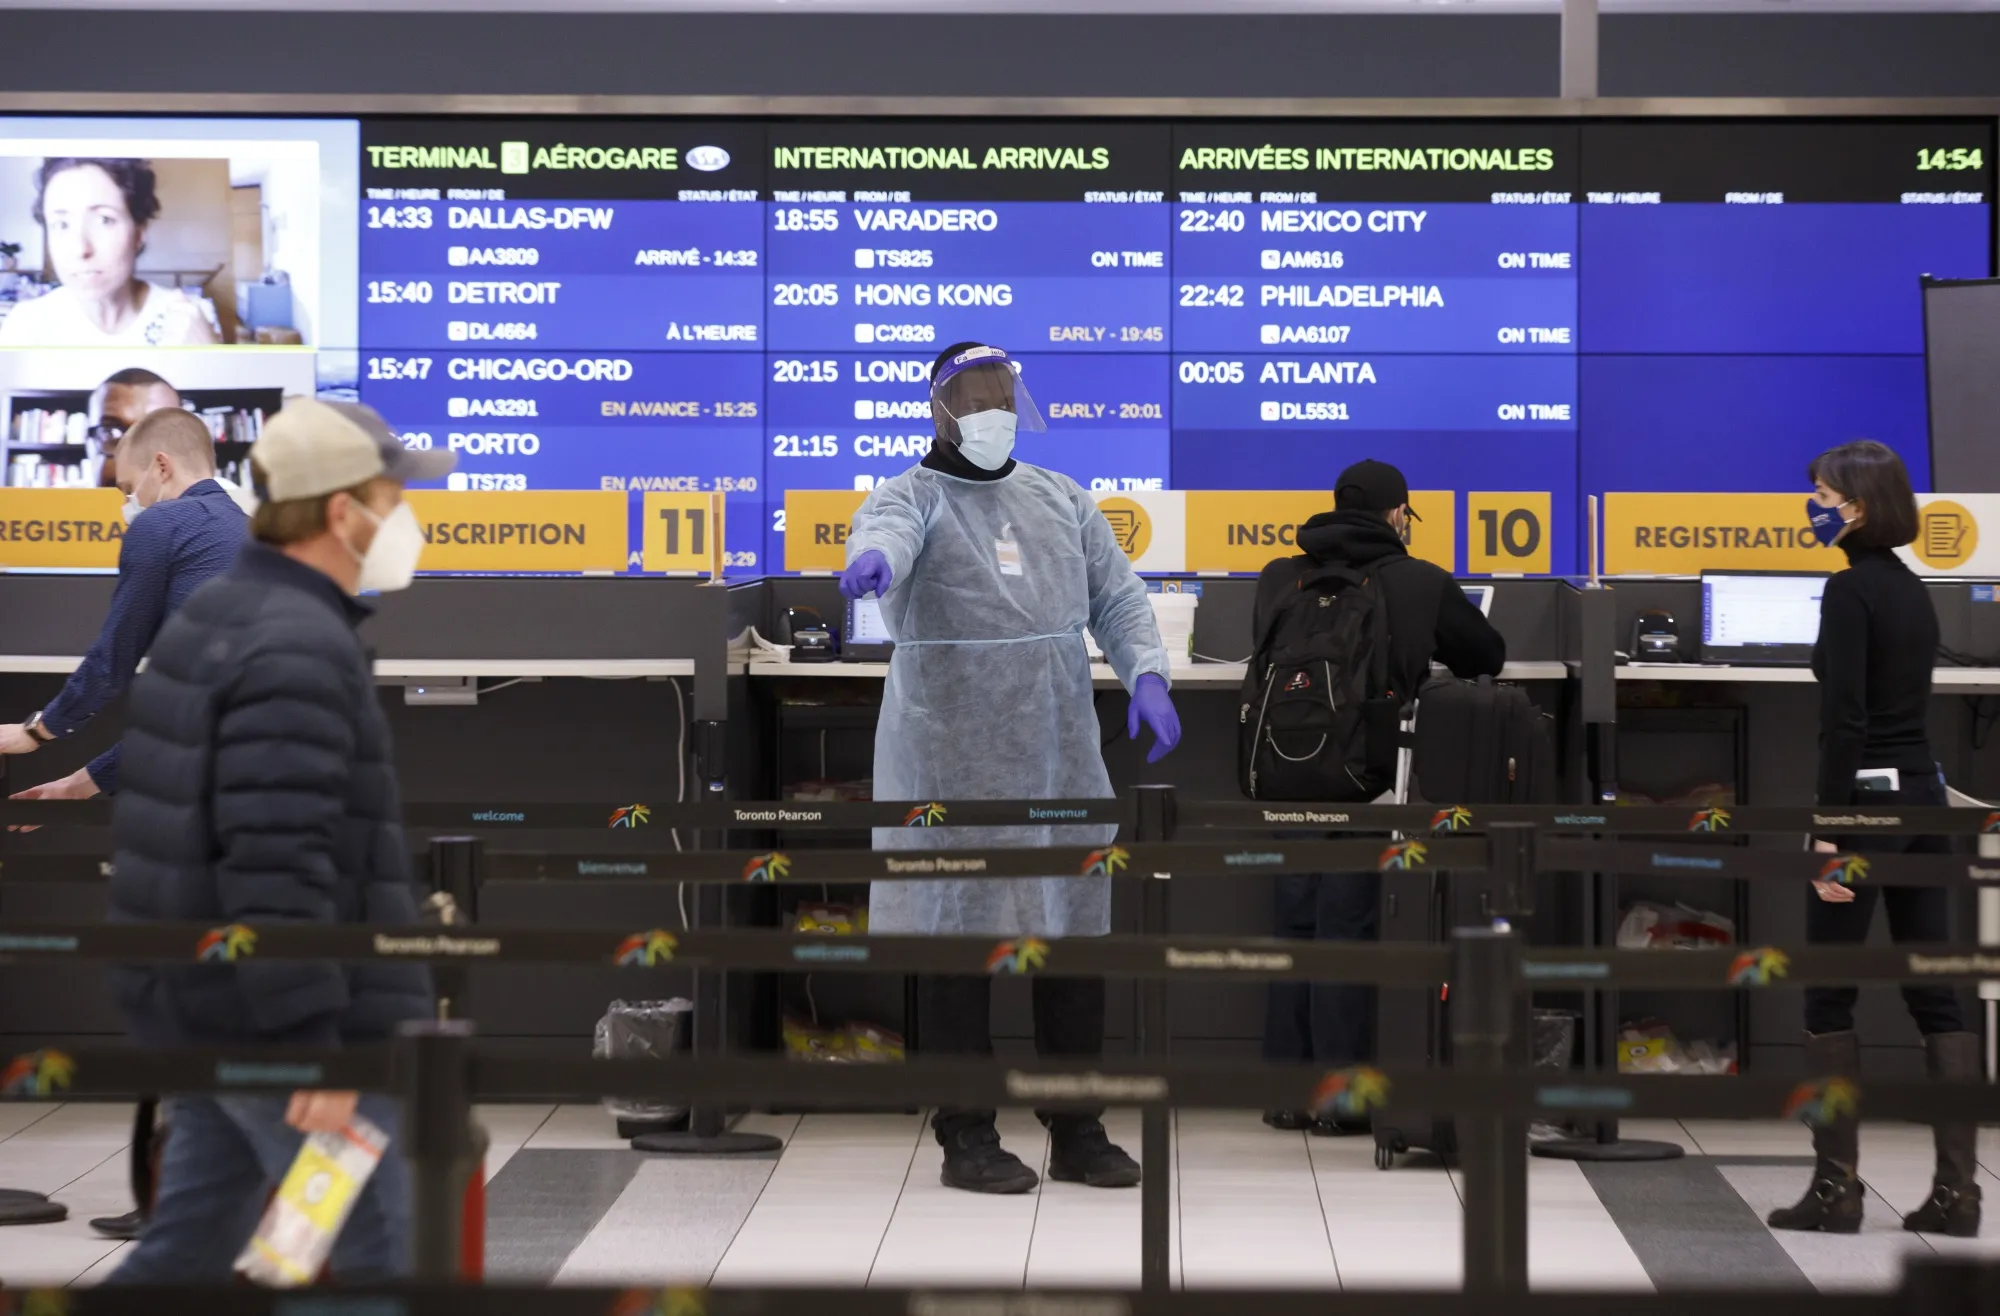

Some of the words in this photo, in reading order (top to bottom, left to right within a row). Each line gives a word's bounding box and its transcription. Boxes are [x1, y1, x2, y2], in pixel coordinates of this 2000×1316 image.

[367, 146, 497, 168] TERMINAL
[532, 143, 677, 169] AÉROGARE
[775, 147, 977, 169] INTERNATIONAL
[983, 148, 1109, 169] ARRIVALS
[1180, 144, 1309, 170] ARRIVÉES
[1316, 148, 1553, 170] INTERNATIONALES
[1917, 149, 1983, 170] 14:54
[368, 207, 432, 228] 14:33
[449, 207, 613, 229] DALLAS-DFW
[775, 209, 838, 231] 18:55
[854, 209, 997, 231] VARADERO
[1180, 210, 1244, 232] 22:40
[1262, 210, 1362, 232] MEXICO
[1368, 210, 1426, 232] CITY
[469, 248, 539, 265] AA3809
[635, 248, 700, 265] ARRIVÉ
[714, 251, 757, 266] 14:32
[876, 250, 933, 267] TS825
[1092, 251, 1118, 267] ON
[1122, 252, 1163, 267] TIME
[1281, 251, 1343, 268] AM616
[1498, 253, 1525, 268] ON
[1529, 253, 1570, 268] TIME
[368, 282, 432, 303] 15:40
[448, 282, 561, 304] DETROIT
[774, 284, 838, 305] 20:05
[855, 284, 931, 305] HONG
[938, 284, 1012, 306] KONG
[1180, 285, 1244, 306] 22:42
[1261, 285, 1444, 307] PHILADELPHIA
[469, 323, 537, 340] DL4664
[667, 322, 681, 340] À
[683, 325, 757, 340] L'HEURE
[875, 325, 935, 342] CX826
[1050, 327, 1105, 341] EARLY
[1121, 327, 1163, 341] 19:45
[1281, 326, 1350, 343] AA6107
[1498, 328, 1525, 343] ON
[1528, 328, 1570, 343] TIME
[368, 358, 432, 379] 15:47
[448, 358, 632, 381] CHICAGO-ORD
[774, 360, 838, 382] 20:15
[1179, 362, 1244, 383] 00:05
[1260, 362, 1376, 383] ATLANTA
[469, 399, 538, 416] AA3291
[601, 401, 625, 416] EN
[629, 402, 699, 416] AVANCE
[715, 402, 757, 417] 15:25
[876, 402, 931, 418] BA099
[1050, 403, 1105, 418] EARLY
[1120, 404, 1162, 418] 20:01
[1282, 403, 1349, 420] DL5531
[1498, 404, 1525, 420] ON
[1528, 404, 1570, 420] TIME
[448, 433, 539, 455] PORTO
[774, 435, 838, 456] 21:15
[469, 474, 526, 490] TS733
[601, 476, 626, 491] EN
[629, 477, 699, 491] AVANCE
[714, 477, 757, 491] 15:40
[1091, 478, 1118, 491] ON
[1121, 478, 1163, 491] TIME
[420, 523, 585, 545] NSCRIPTION
[660, 509, 704, 554] 11
[1479, 509, 1540, 557] 10
[1635, 526, 1816, 548] REGISTRATIO
[472, 810, 525, 822] welcome
[734, 809, 777, 821] Toronto
[778, 809, 822, 821] Pearson
[1029, 807, 1088, 819] bienvenue
[1262, 810, 1305, 822] Toronto
[1305, 811, 1350, 823] Pearson
[1554, 814, 1606, 825] welcome
[1812, 814, 1859, 826] Toronto
[1856, 814, 1901, 826] Pearson
[886, 858, 936, 873] Toronto
[935, 857, 987, 872] Pearson
[1224, 852, 1284, 865] welcome
[578, 861, 647, 875] bienvenue
